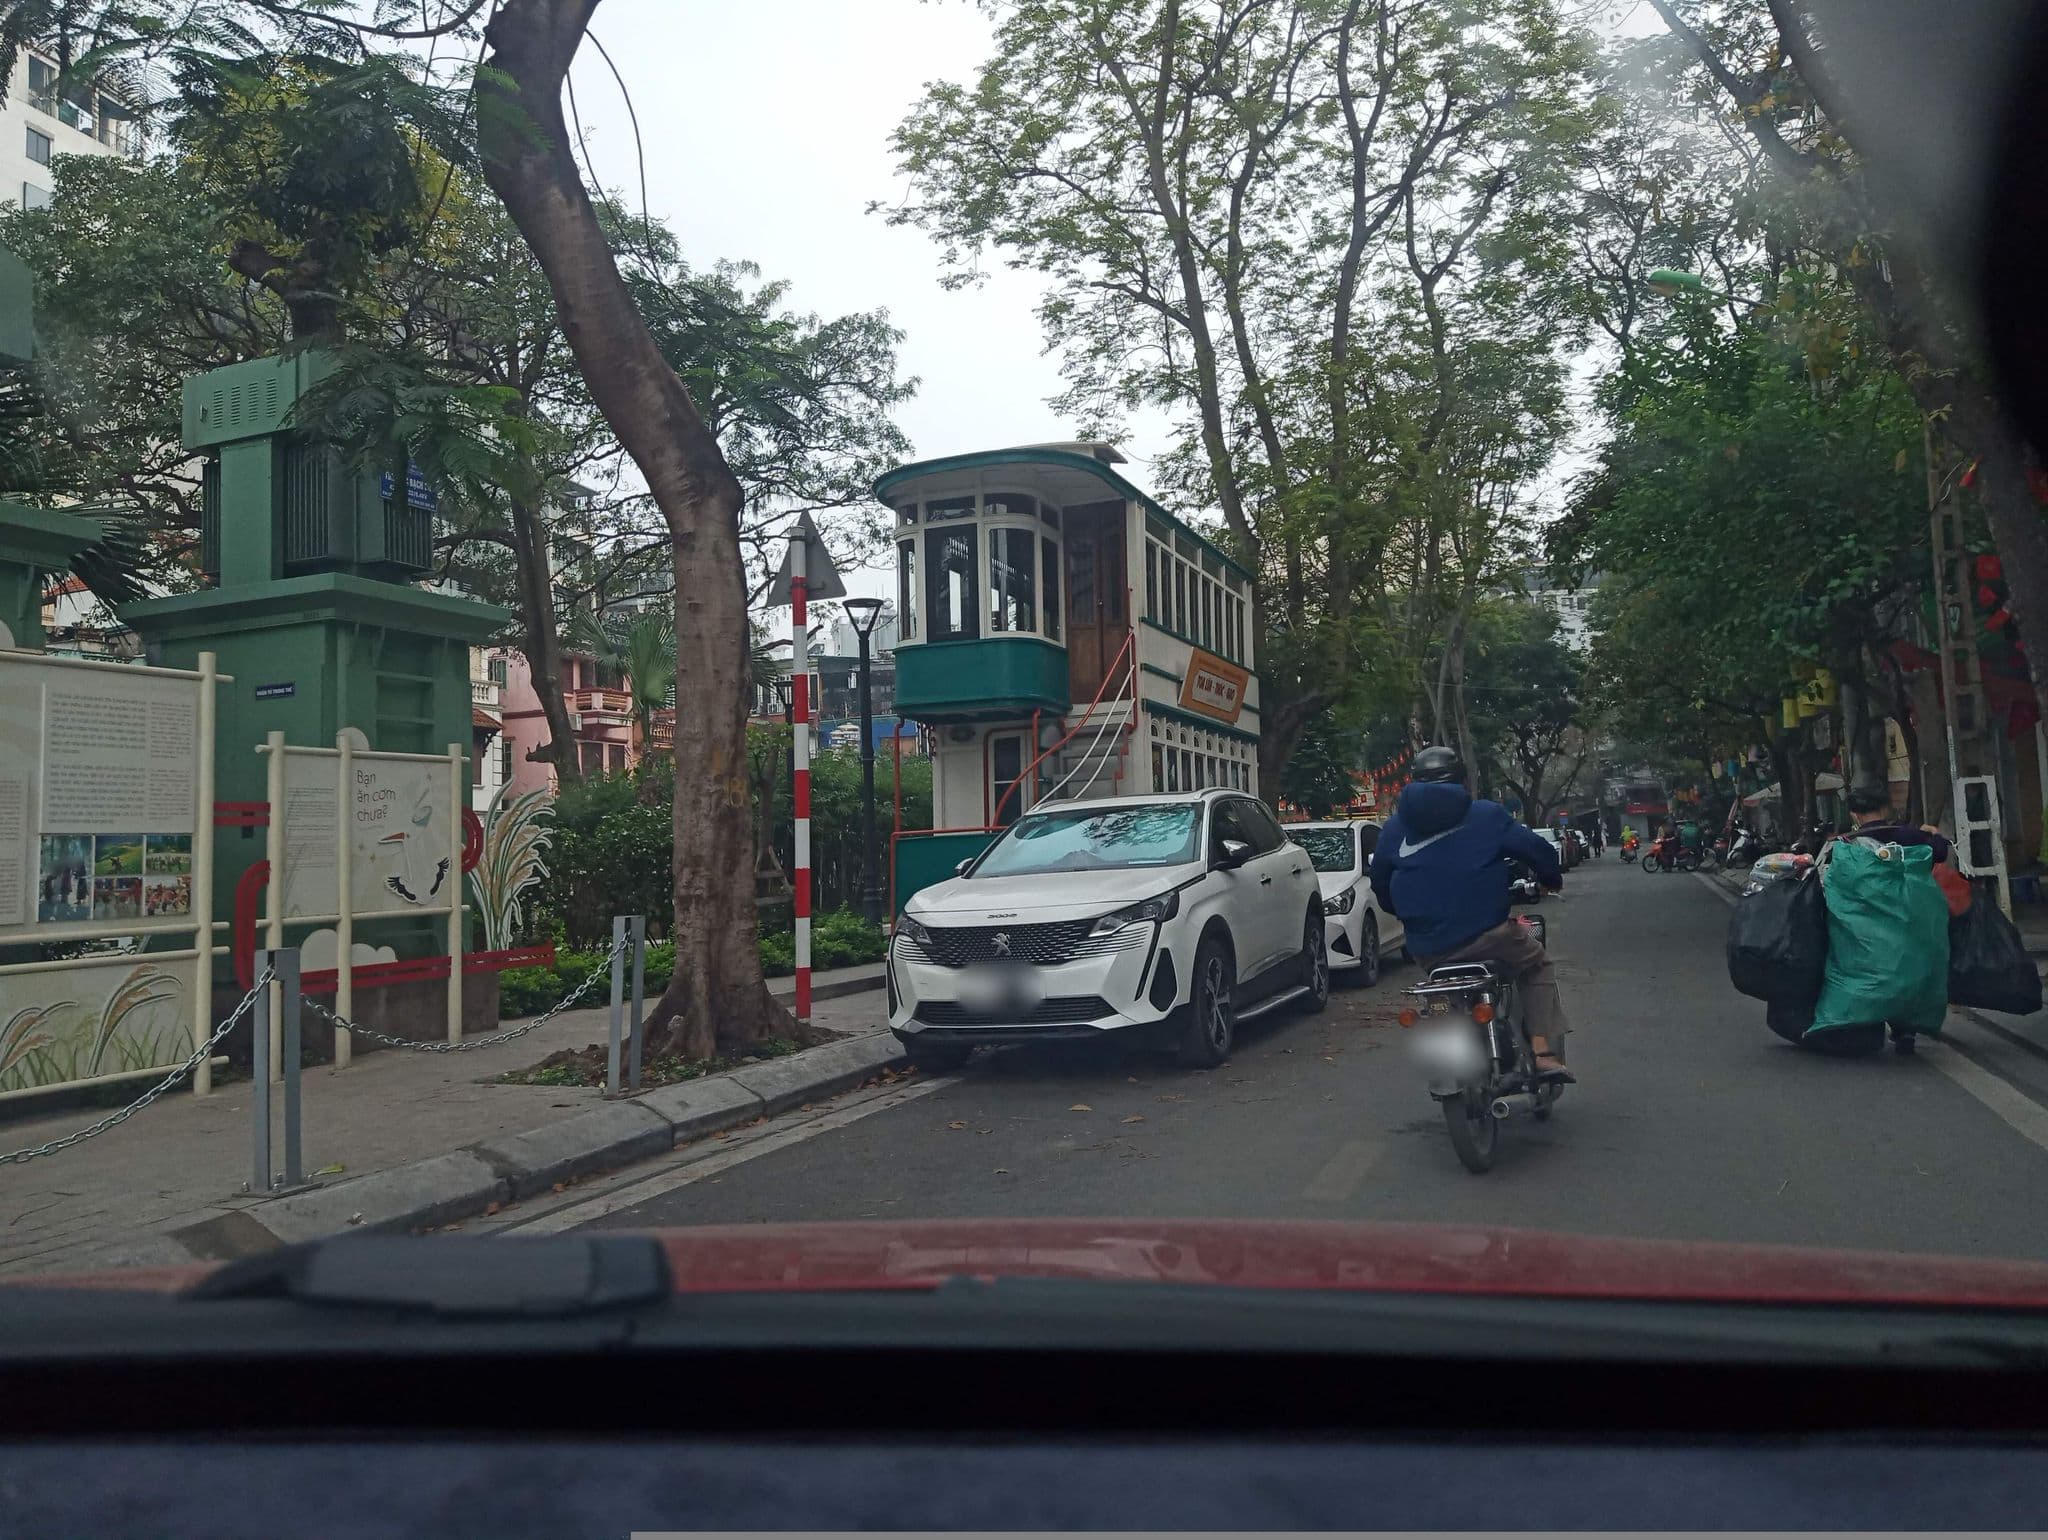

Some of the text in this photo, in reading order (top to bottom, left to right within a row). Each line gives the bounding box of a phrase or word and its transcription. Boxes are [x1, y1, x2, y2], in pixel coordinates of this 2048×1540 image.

[357, 769, 377, 788] Bạn
[357, 788, 396, 803] ăn cơm
